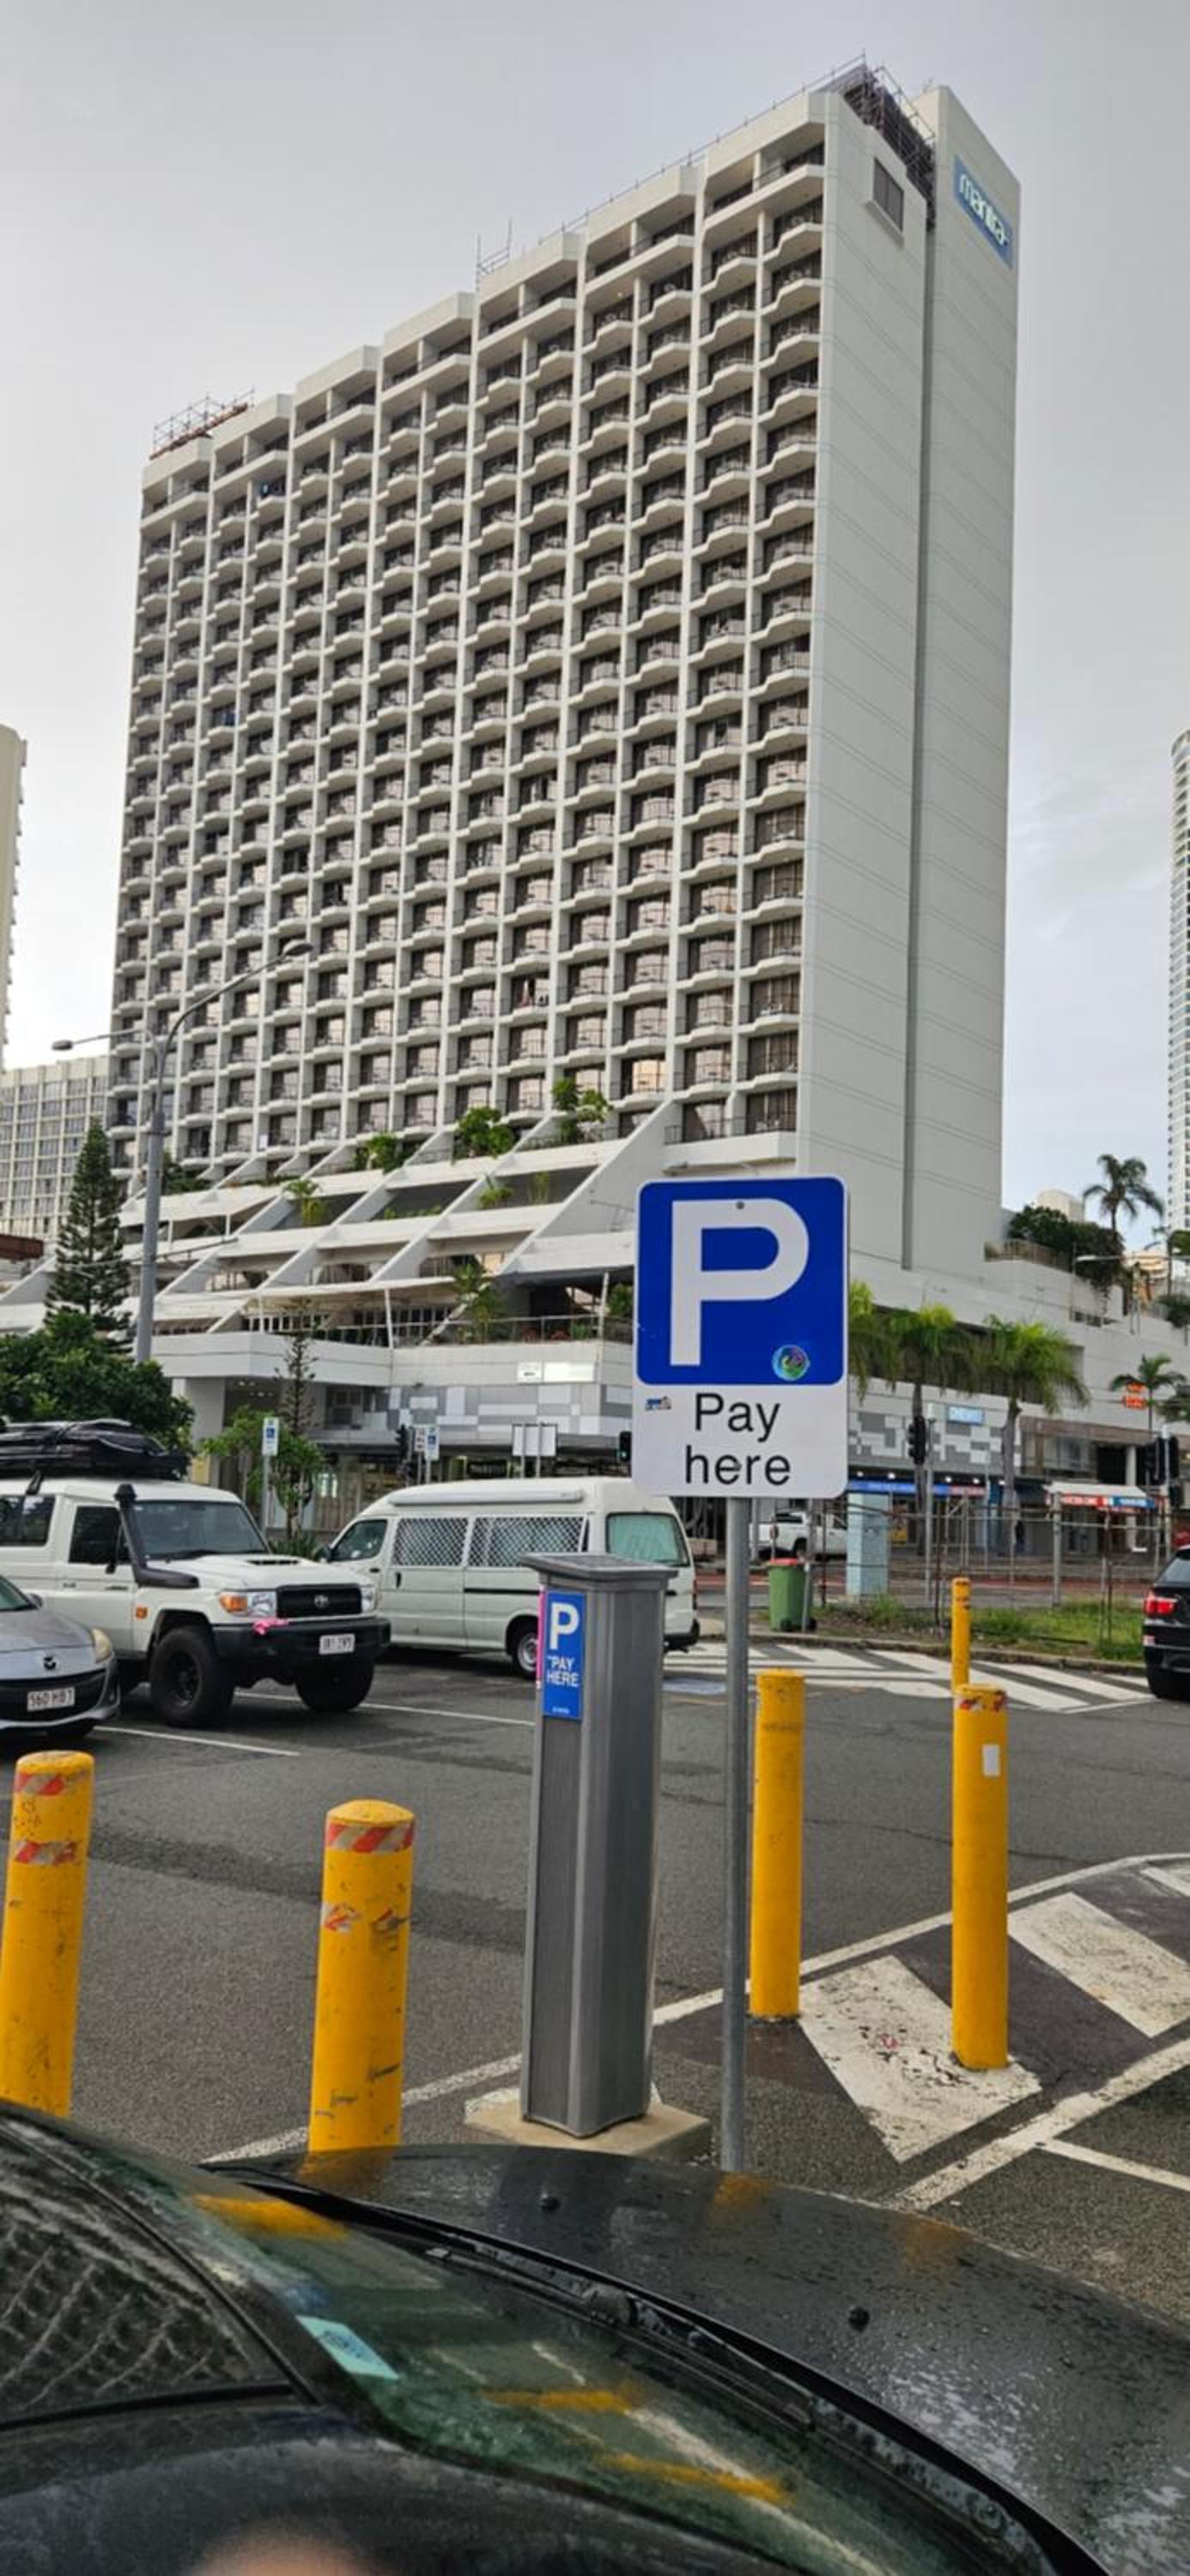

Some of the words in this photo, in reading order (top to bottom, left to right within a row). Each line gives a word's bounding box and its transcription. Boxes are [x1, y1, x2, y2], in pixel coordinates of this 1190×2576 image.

[959, 174, 1009, 246] mantra
[671, 1198, 809, 1365] P
[695, 1392, 780, 1443] Pay
[685, 1444, 791, 1485] here
[549, 1601, 580, 1649] P
[547, 1670, 580, 1687] HERE
[549, 1656, 574, 1672] PAY
